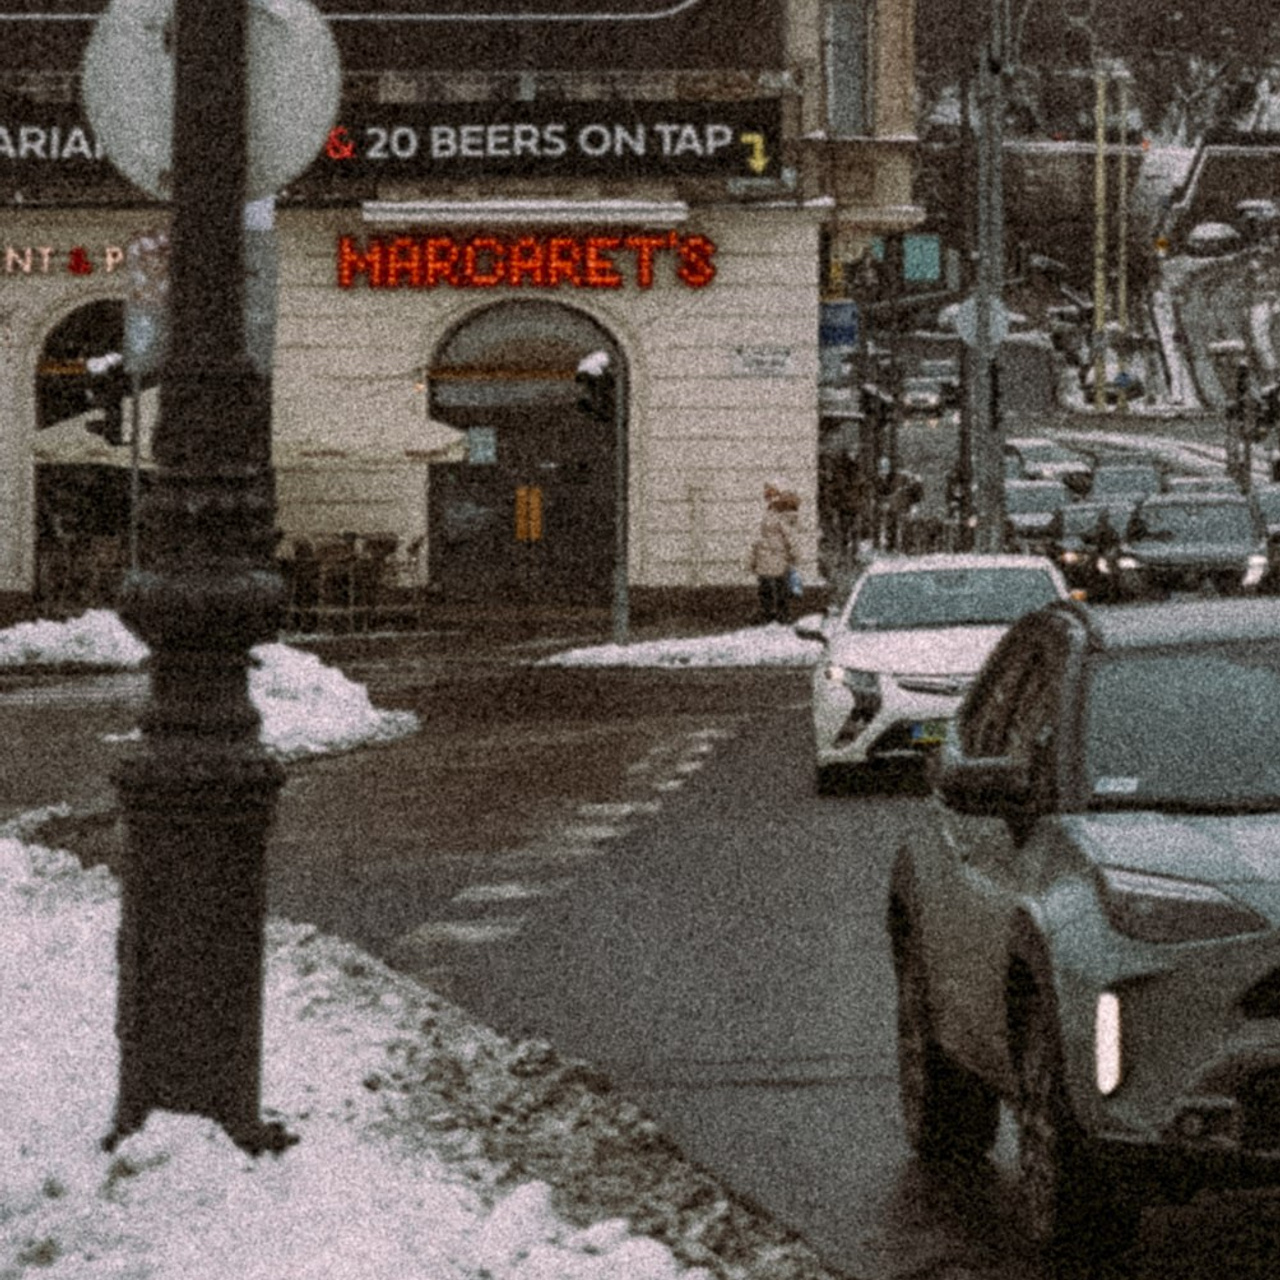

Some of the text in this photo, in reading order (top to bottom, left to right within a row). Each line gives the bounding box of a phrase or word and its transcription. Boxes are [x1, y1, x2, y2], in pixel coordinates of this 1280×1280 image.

[326, 126, 355, 159] &
[366, 127, 418, 158] 20
[431, 125, 567, 158] BEERS
[579, 125, 645, 157] ON
[656, 123, 733, 156] TAP
